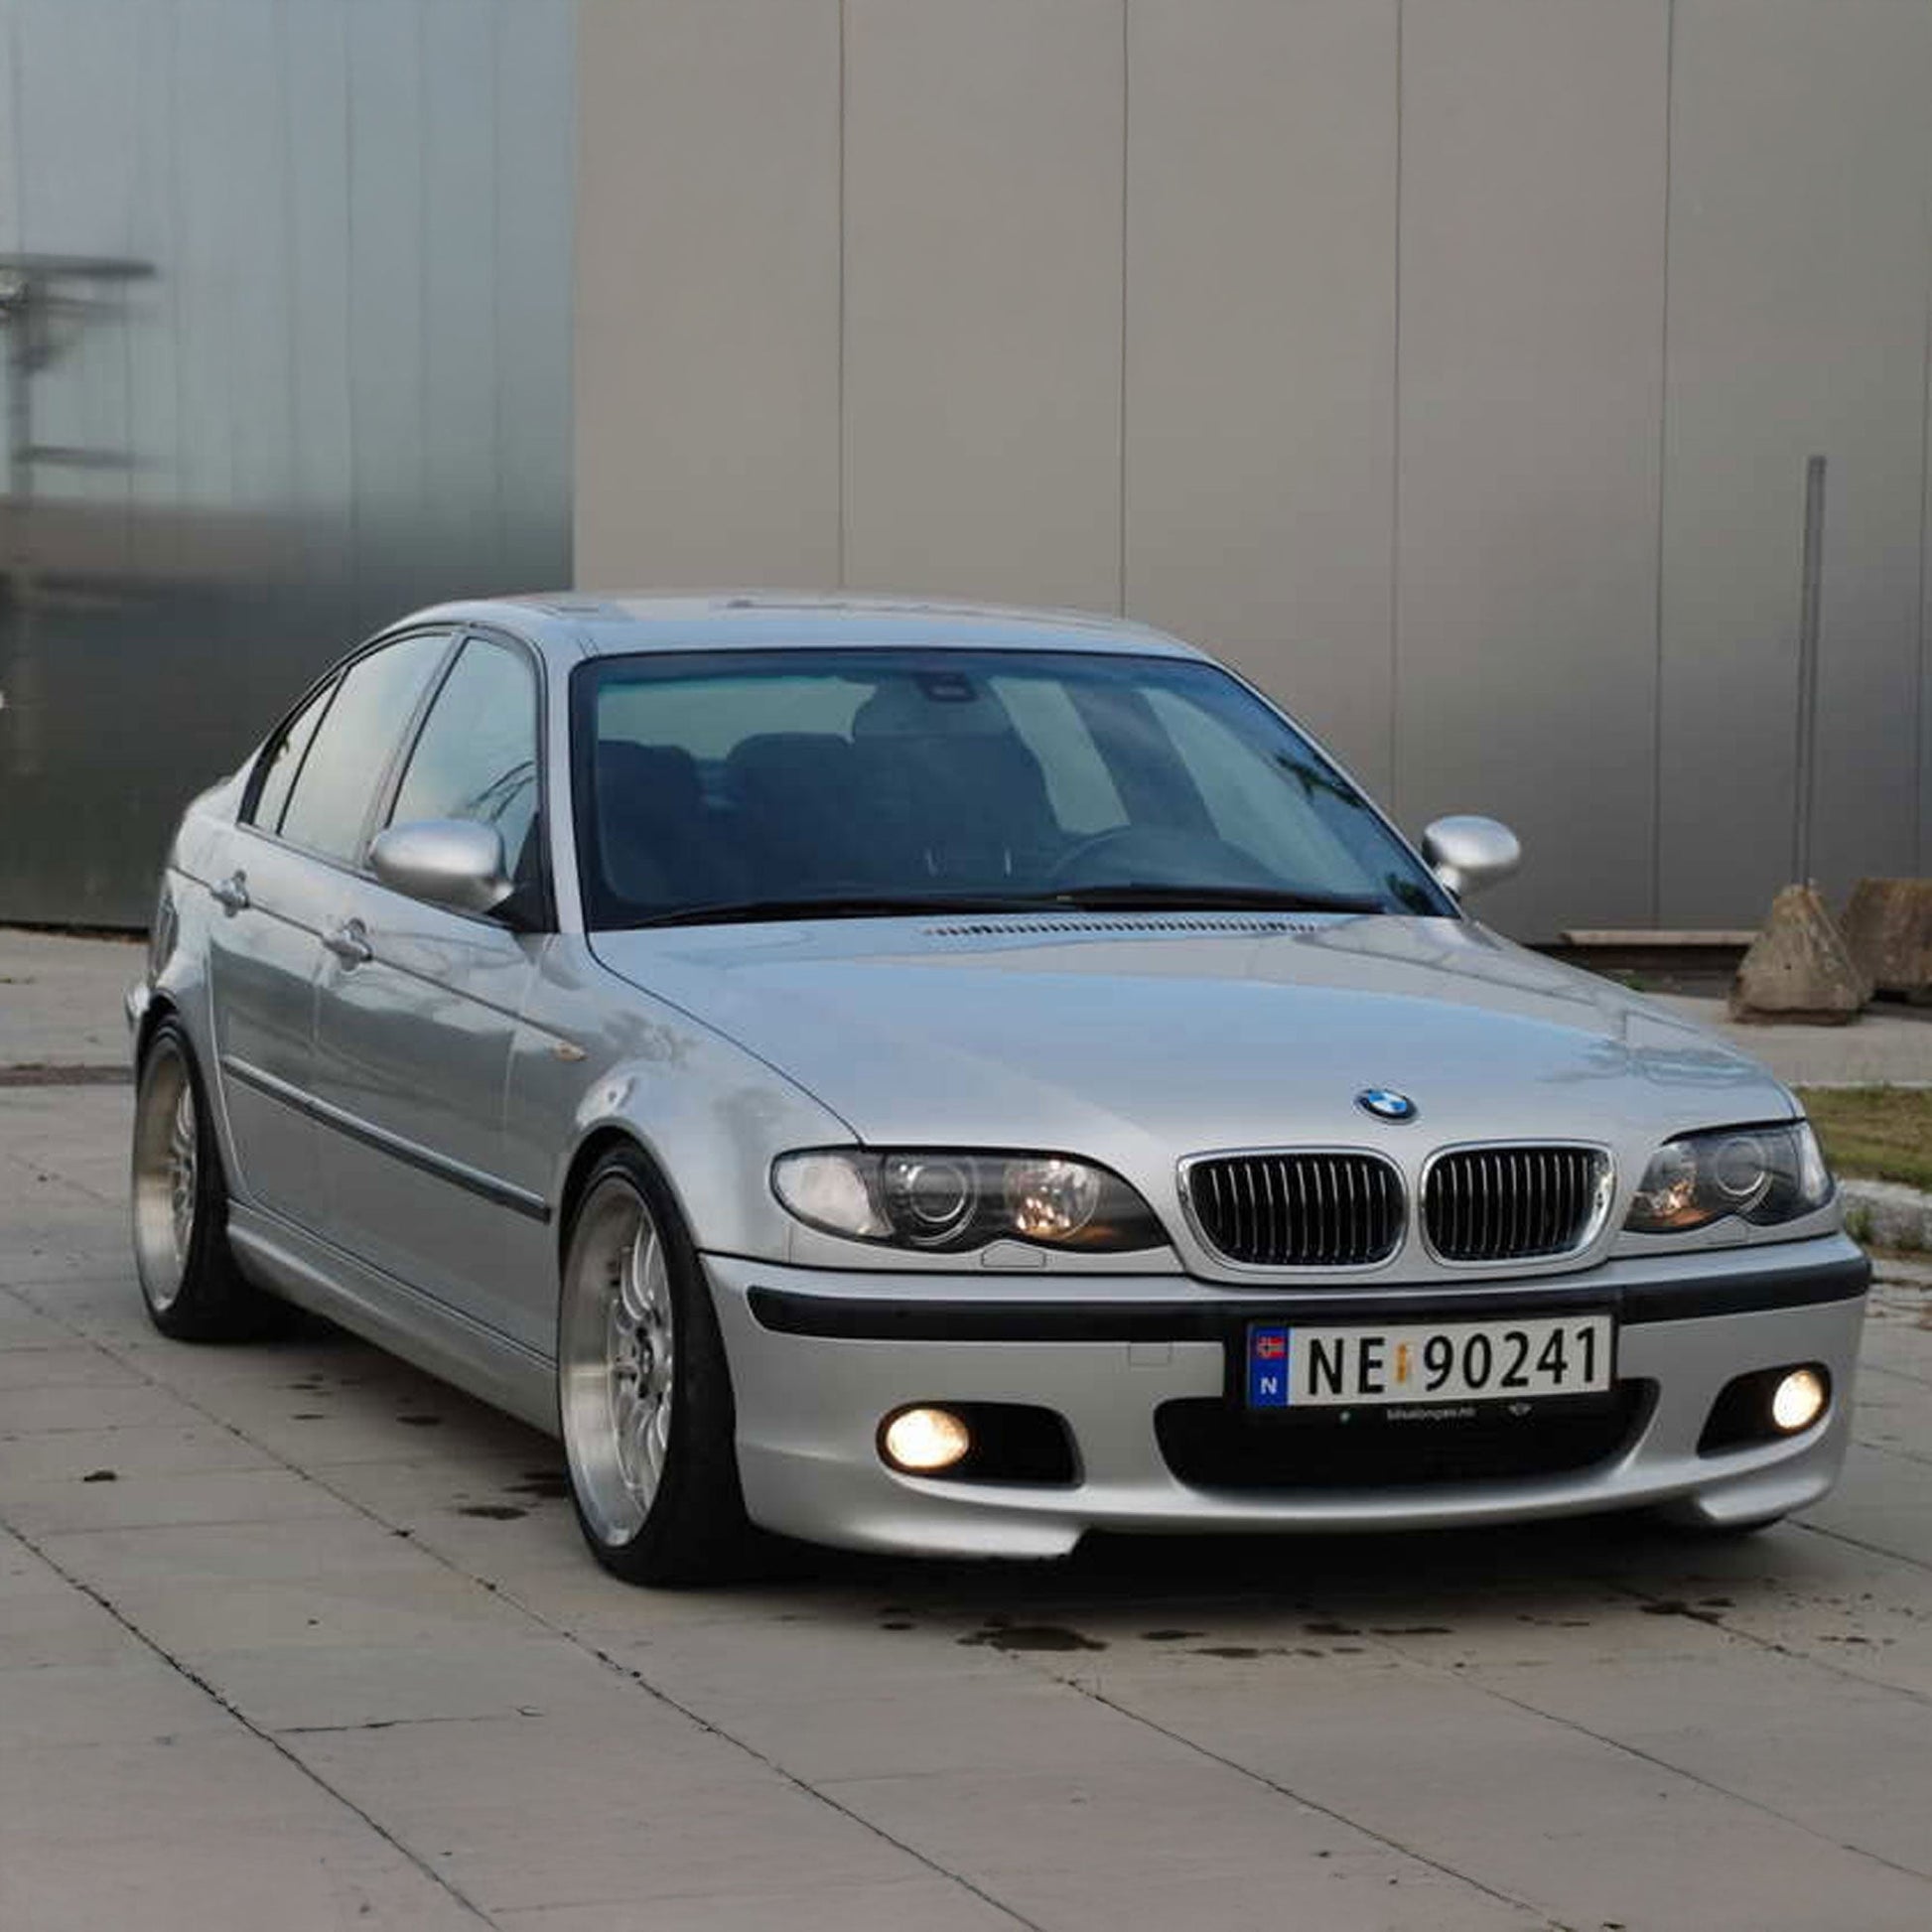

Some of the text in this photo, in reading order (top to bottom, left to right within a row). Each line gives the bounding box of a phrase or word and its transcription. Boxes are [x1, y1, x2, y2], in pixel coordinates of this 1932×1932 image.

[1309, 1325, 1595, 1395] NE 90241
[1260, 1377, 1278, 1394] N
